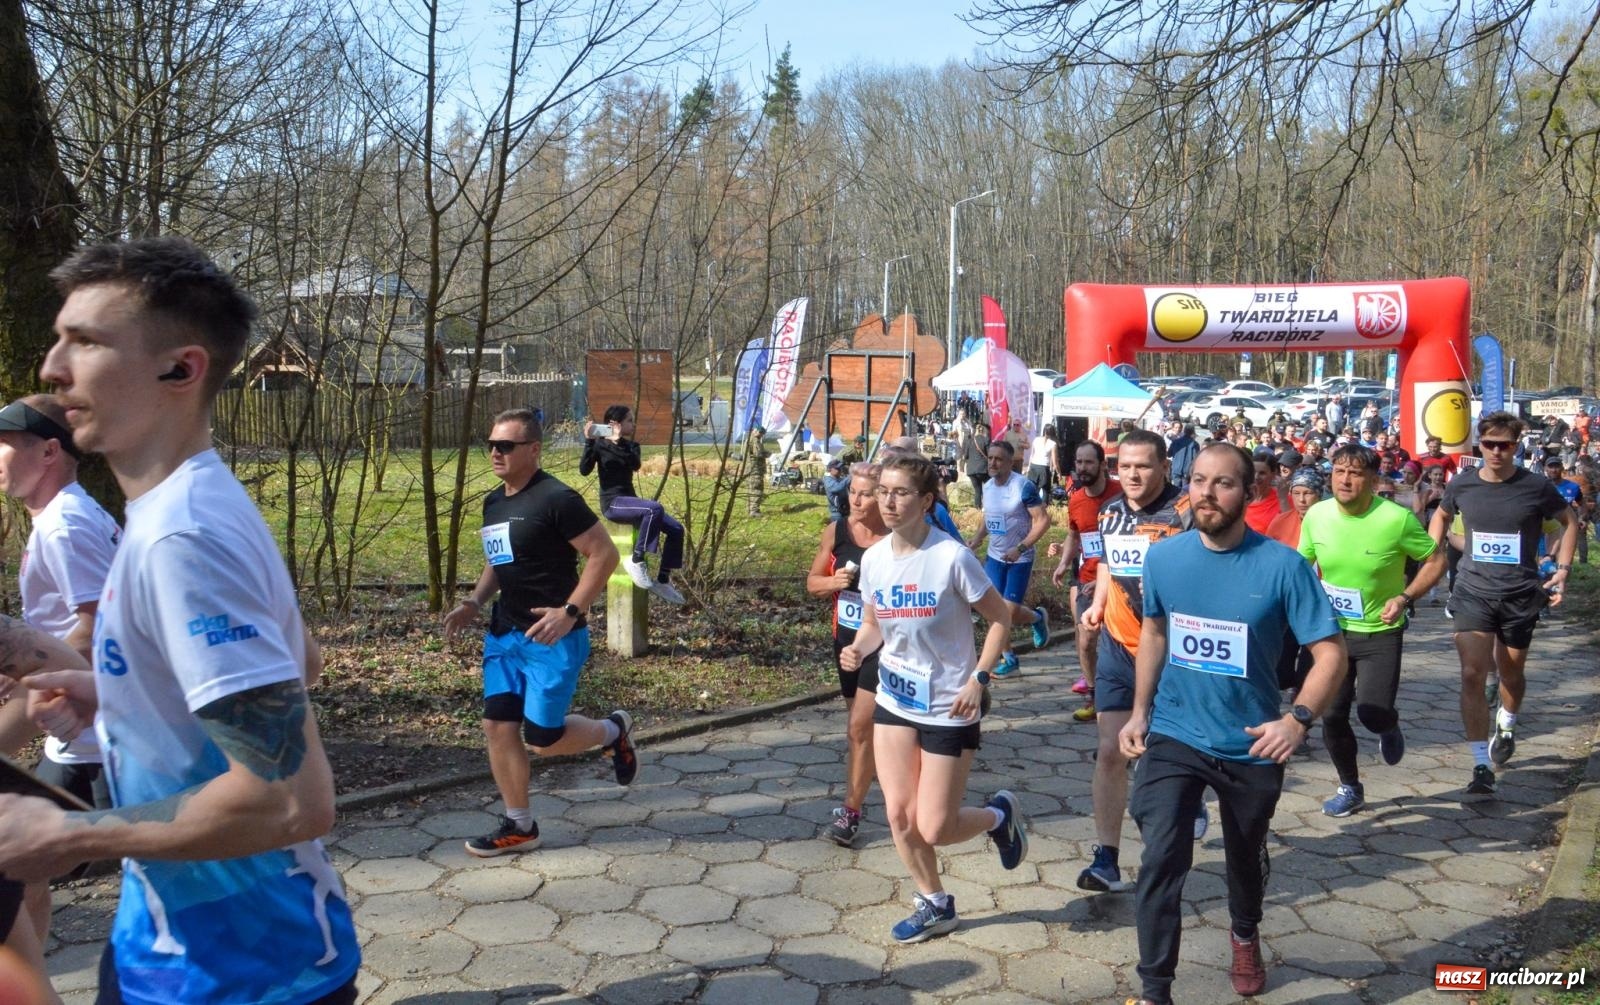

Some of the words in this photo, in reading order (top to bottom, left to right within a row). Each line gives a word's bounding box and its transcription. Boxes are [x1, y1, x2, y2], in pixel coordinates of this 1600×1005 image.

[1254, 292, 1299, 303] BIEG
[1219, 309, 1339, 323] TWARDZIELA
[487, 538, 504, 555] 001
[1090, 541, 1100, 551] 11
[1481, 542, 1511, 555] 092
[1112, 549, 1142, 565] 042
[1327, 594, 1353, 610] 062
[845, 604, 863, 620] 01
[1182, 634, 1231, 661] 095
[888, 672, 917, 698] 015
